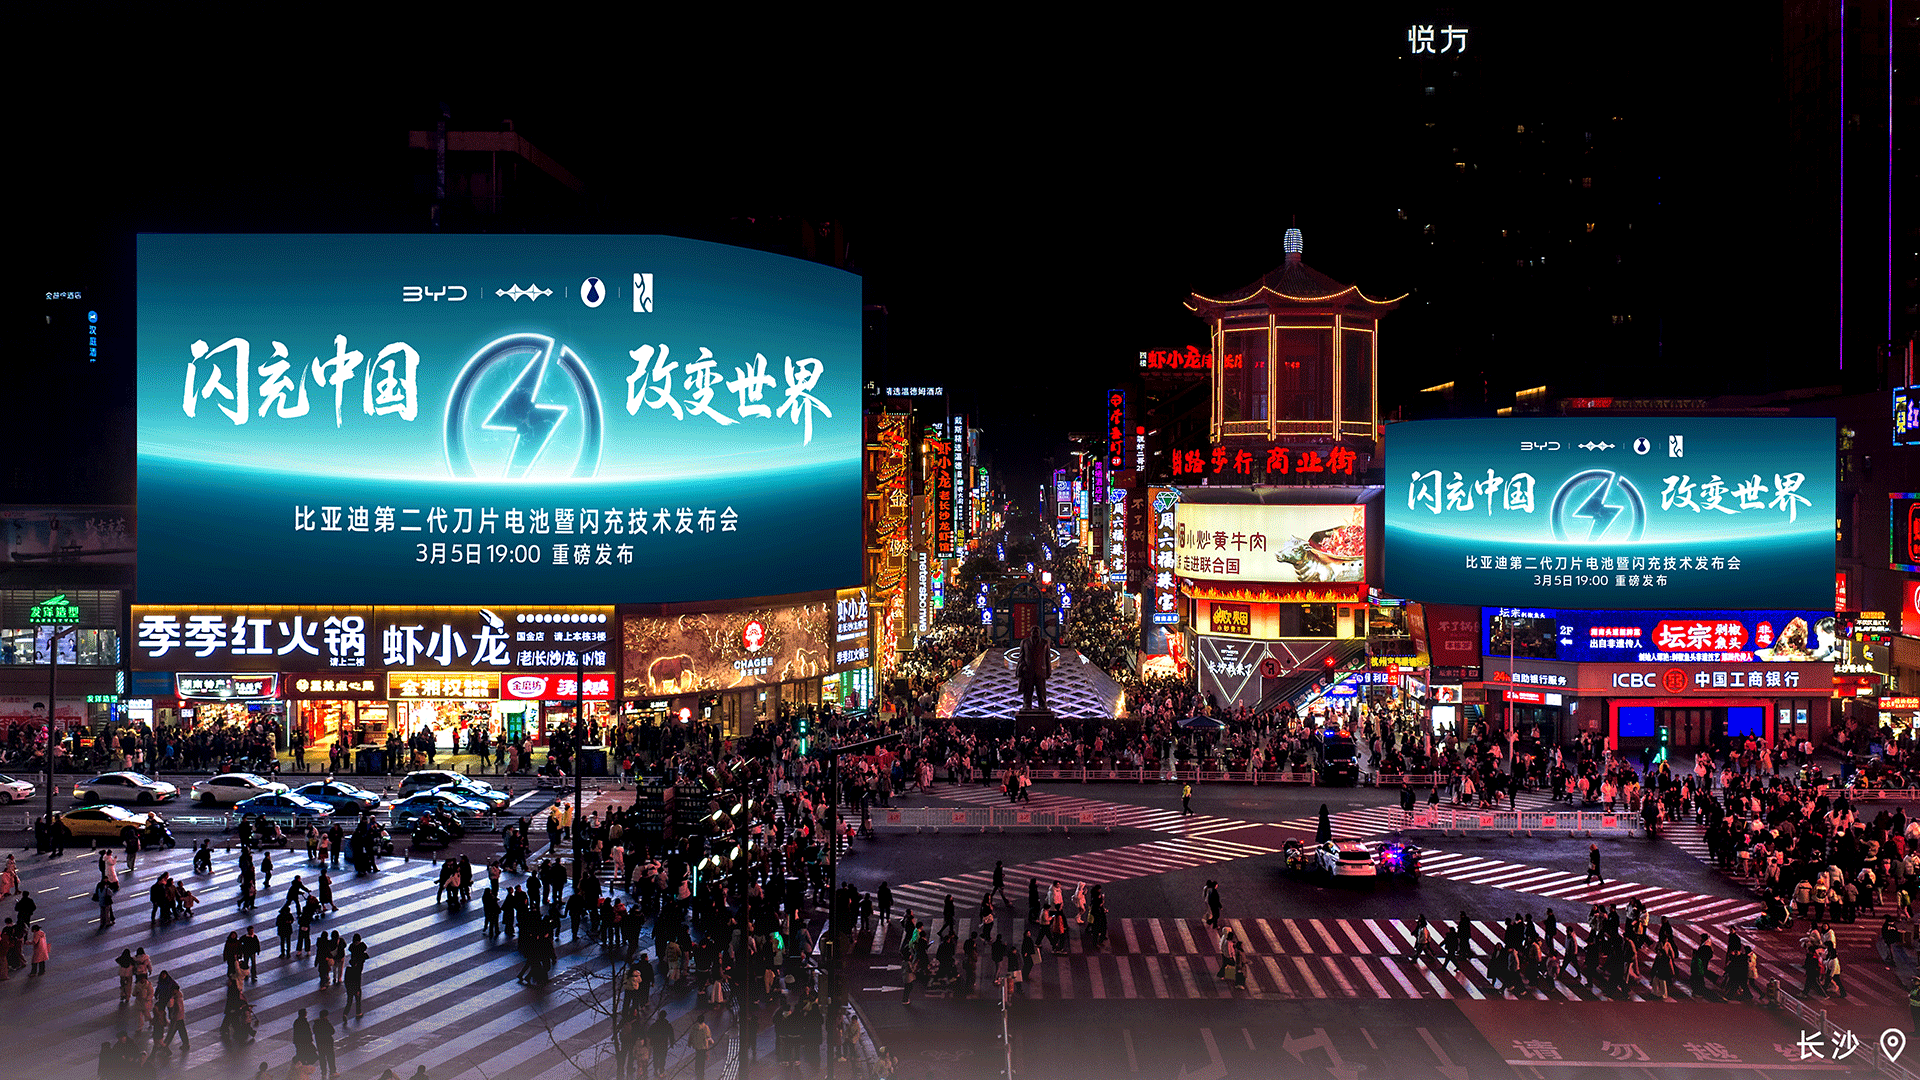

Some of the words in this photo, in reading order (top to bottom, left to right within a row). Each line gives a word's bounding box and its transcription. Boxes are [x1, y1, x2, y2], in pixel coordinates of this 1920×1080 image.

[1408, 25, 1468, 53] 悦方
[403, 286, 468, 302] BYD
[183, 334, 420, 428] 闪充中国
[626, 344, 832, 446] 改变世界
[1521, 441, 1560, 450] BYD
[1407, 469, 1535, 516] 闪充中国
[1661, 473, 1812, 524] 改变世界
[294, 506, 738, 534] 比亚迪第二代刀片电池暨闪充技术发布会
[1112, 502, 1125, 571] 周六福珠宝
[1187, 531, 1267, 552] 小炒黄牛肉
[415, 544, 541, 565] 3月5日19:00
[552, 543, 634, 565] 重磅发布
[1157, 512, 1175, 611] 周六福珠宝
[1465, 555, 1741, 571] 比亚迪第二代刀片电池暨闪充技术发布会
[1534, 575, 1608, 587] 3月5日19:00
[1615, 574, 1668, 587] 重磅发布
[837, 590, 868, 622] 虾小龙
[138, 615, 365, 657] 季季红火锅
[383, 609, 511, 666] 虾小龙
[516, 631, 545, 641] 国金店
[1560, 626, 1574, 635] 2F
[1658, 623, 1712, 650] 坛宗
[329, 657, 365, 667] 请上二楼
[733, 657, 773, 670] CHAGEE
[512, 680, 542, 691] 金磨坊
[1493, 671, 1511, 682] 24h
[1512, 672, 1567, 686] 自助银行服务
[1612, 673, 1657, 688] ICBC
[1695, 671, 1799, 688] 中国工商银行
